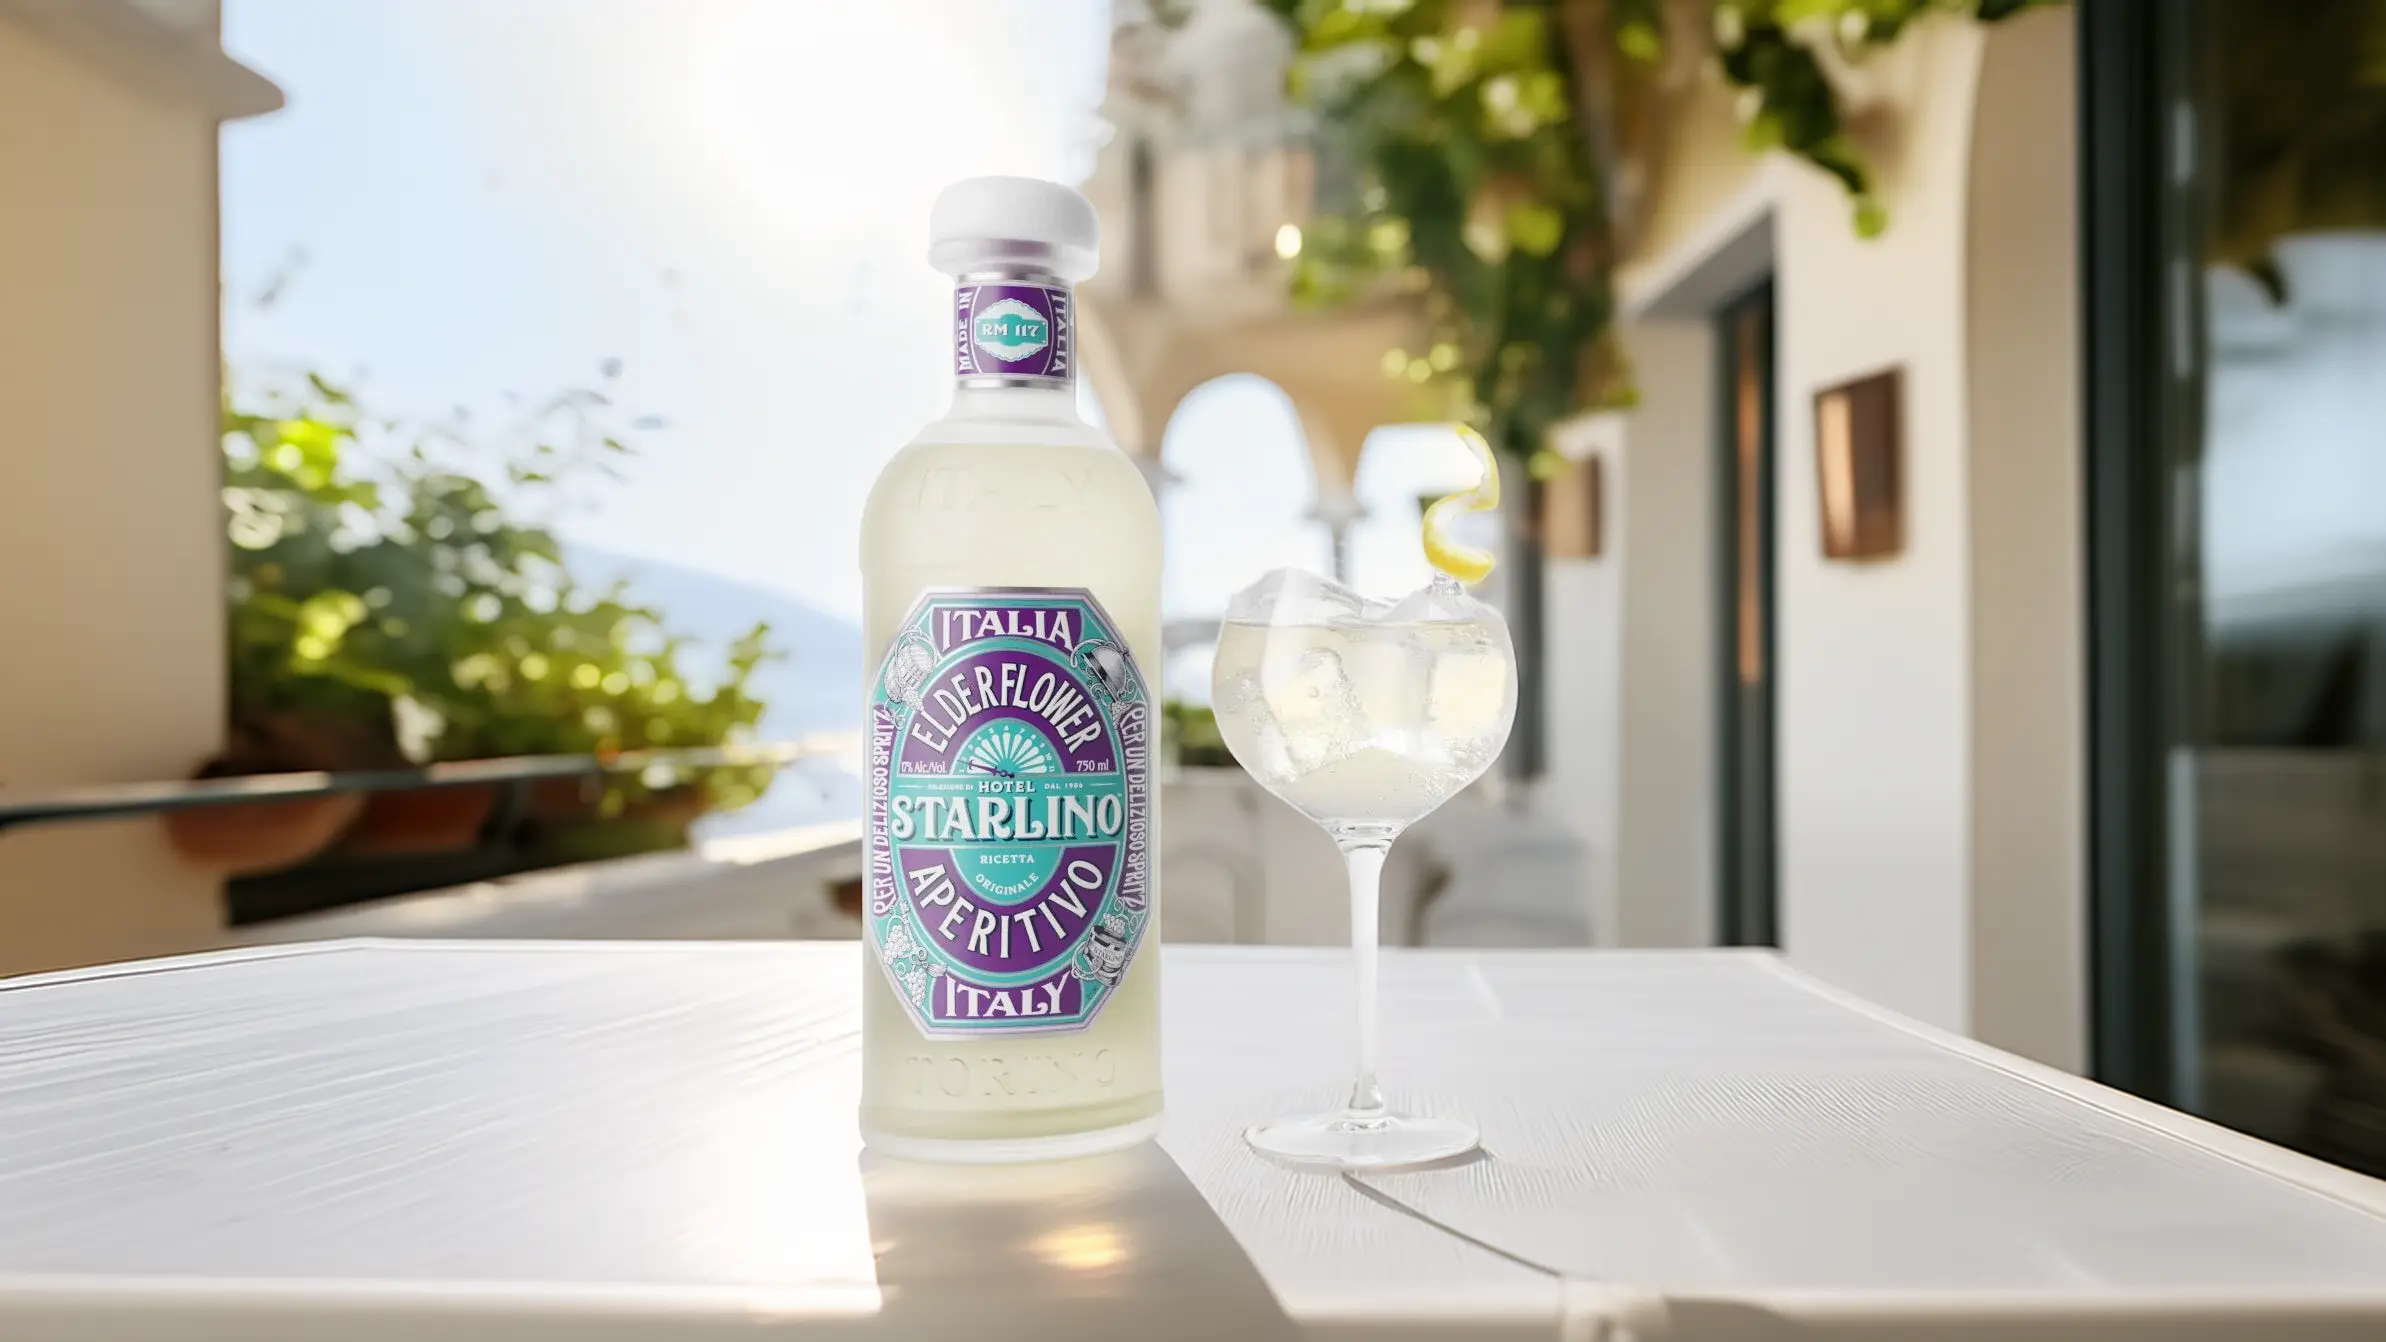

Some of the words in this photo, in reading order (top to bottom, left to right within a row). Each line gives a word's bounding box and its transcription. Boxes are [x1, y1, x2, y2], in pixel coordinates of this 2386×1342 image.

[958, 291, 973, 309] IN
[958, 318, 973, 370] MADE
[982, 323, 1008, 336] RM
[1015, 324, 1040, 337] 117
[1051, 294, 1067, 372] ITALIA
[942, 610, 1075, 651] ITALIA
[911, 663, 1102, 754] ELDERFLOWER
[1120, 707, 1146, 746] PER
[873, 709, 895, 766] SPRITZ
[1077, 760, 1095, 771] 750
[1097, 759, 1109, 771] ml
[1125, 747, 1146, 771] UN
[873, 766, 889, 847] DELIZIOSO
[978, 781, 1036, 793] HOTEL
[891, 793, 1122, 840] STARLINO
[1128, 772, 1146, 850] DELIZIOSO
[873, 851, 892, 876] UN
[980, 855, 1034, 864] RICETTA
[1121, 852, 1146, 908] SPRITZ
[873, 878, 896, 916] PER
[975, 872, 1039, 895] ORIGINALE
[909, 860, 1103, 958] APERITIVO
[945, 971, 1070, 1017] ITALY
